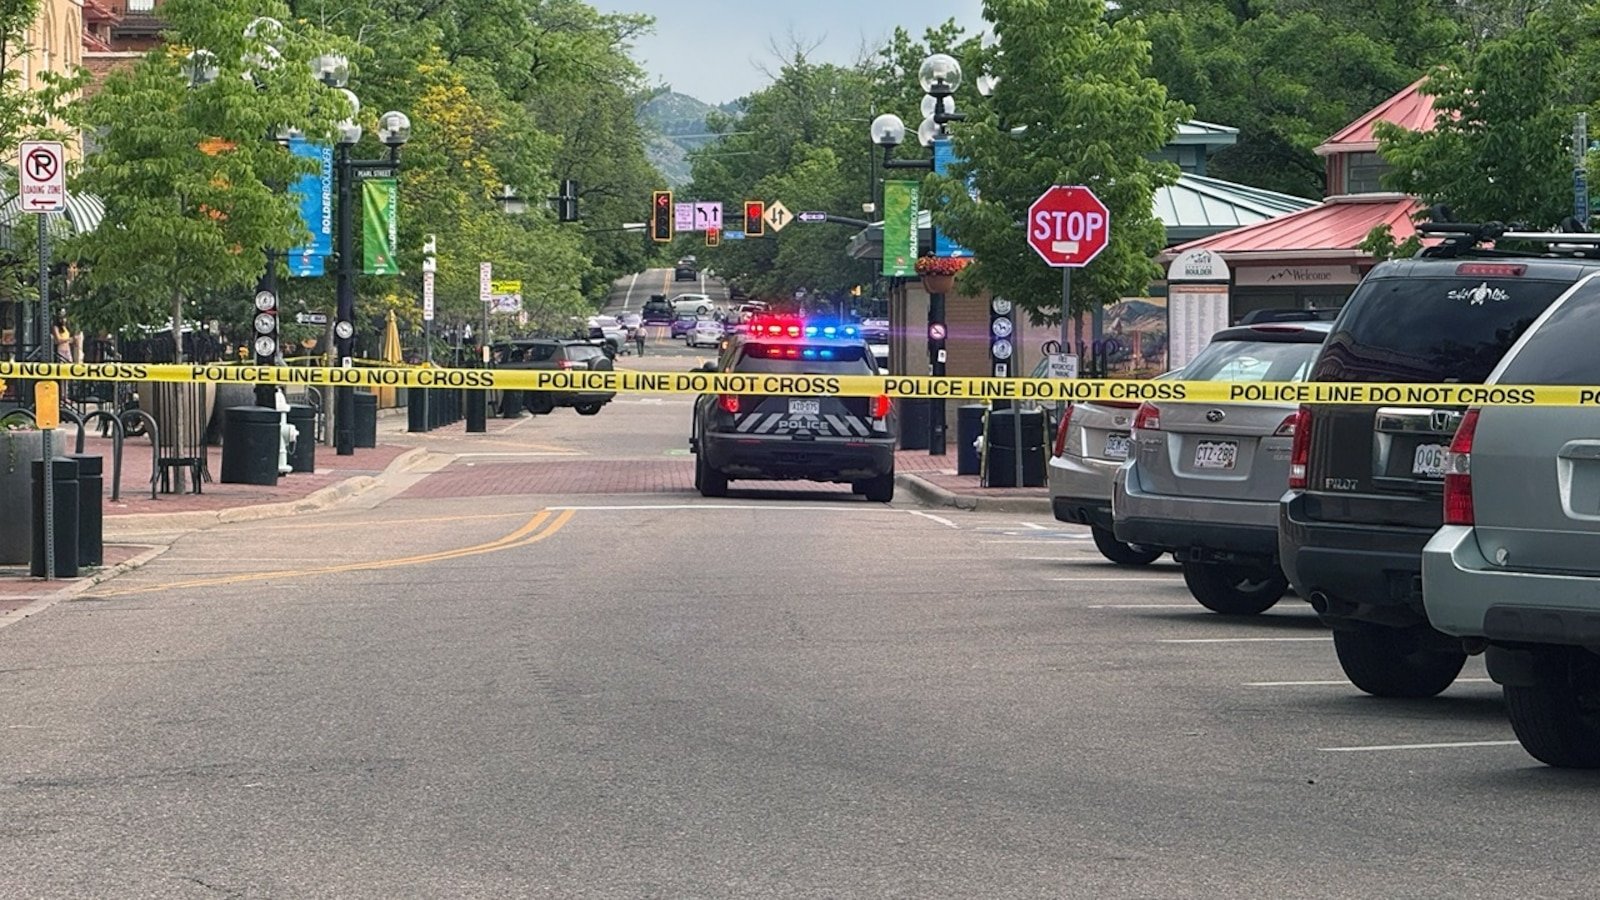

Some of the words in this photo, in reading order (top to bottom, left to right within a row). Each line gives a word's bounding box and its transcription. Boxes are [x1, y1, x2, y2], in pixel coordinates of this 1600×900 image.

[24, 185, 45, 194] LOADING
[47, 185, 61, 194] ZONE
[322, 147, 332, 234] BOLDERBOULDER
[910, 188, 918, 259] BOLDERBOULDER
[1034, 210, 1103, 241] STOP
[1293, 268, 1332, 281] Welcome
[20, 364, 60, 377] NOT
[70, 364, 147, 379] CROSS
[192, 367, 270, 381] POLICE
[276, 368, 323, 382] LINE
[329, 369, 361, 384] DO
[367, 370, 408, 385] NOT
[417, 370, 494, 386] CROSS
[538, 372, 617, 388] POLICE
[623, 373, 670, 389] LINE
[677, 374, 708, 390] DO
[713, 375, 759, 391] NOT
[763, 377, 840, 393] CROSS
[884, 379, 962, 395] POLICE
[968, 381, 1016, 396] LINE
[1022, 381, 1054, 397] DO
[1059, 383, 1105, 398] NOT
[1110, 383, 1186, 399] CROSS
[1230, 385, 1310, 400] POLICE
[1315, 386, 1363, 401] LINE
[1369, 387, 1402, 402] DO
[1407, 387, 1454, 402] NOT
[1457, 388, 1535, 404] CROSS
[779, 420, 829, 430] POLICE
[1325, 478, 1359, 490] PILOT
